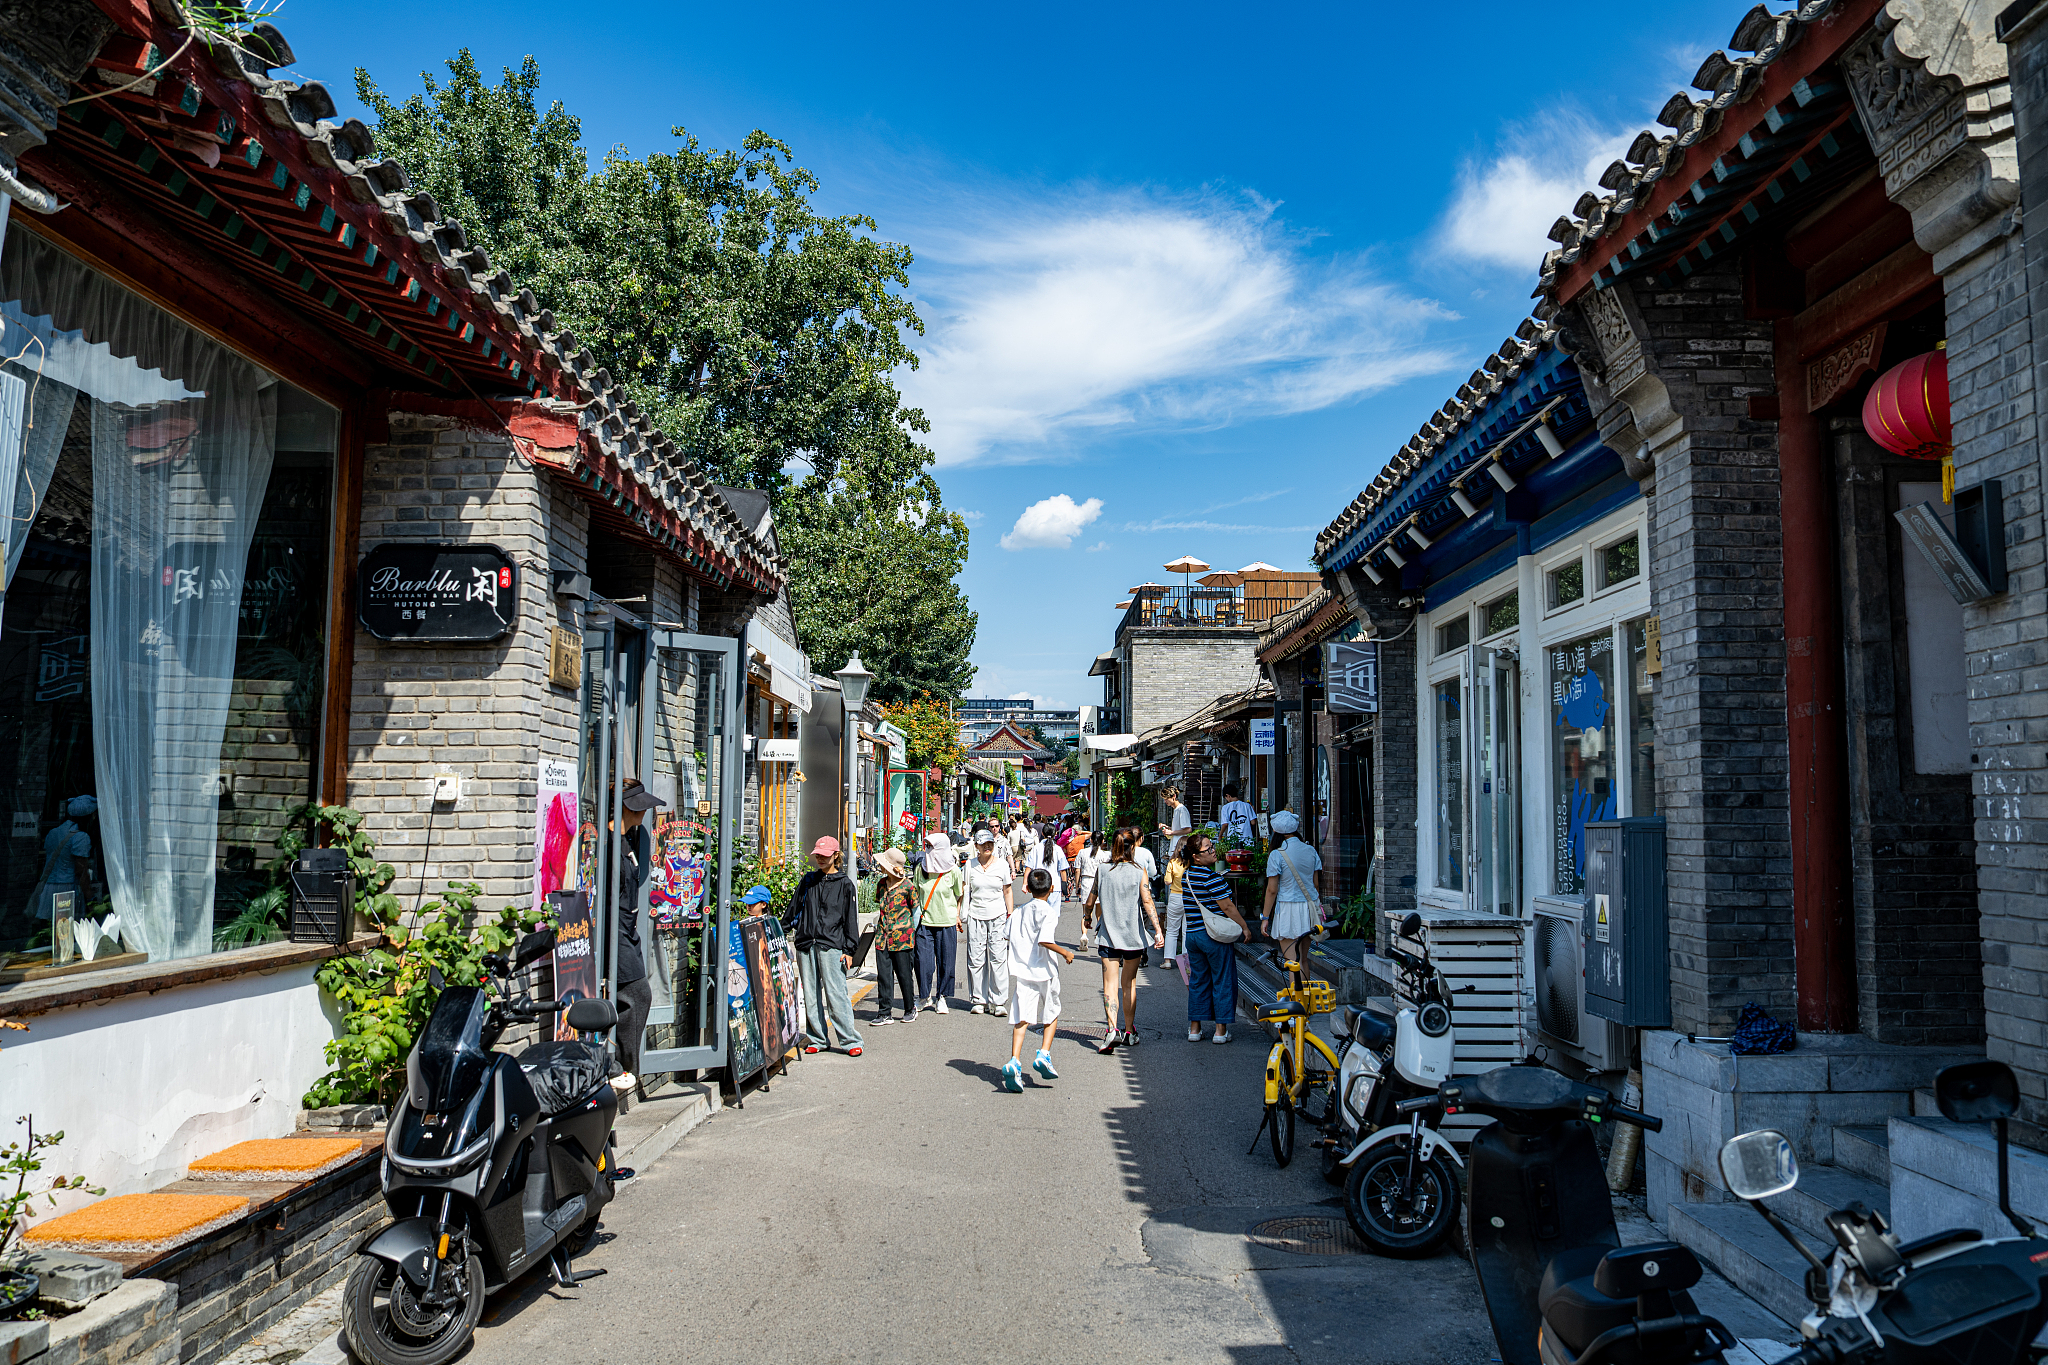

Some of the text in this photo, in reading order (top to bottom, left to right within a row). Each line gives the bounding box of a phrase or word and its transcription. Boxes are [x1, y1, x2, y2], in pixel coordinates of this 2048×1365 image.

[370, 567, 460, 592] Barblu
[466, 567, 499, 611] 闲
[402, 609, 427, 620] 西餐
[564, 654, 573, 677] 31
[700, 803, 709, 811] 推
